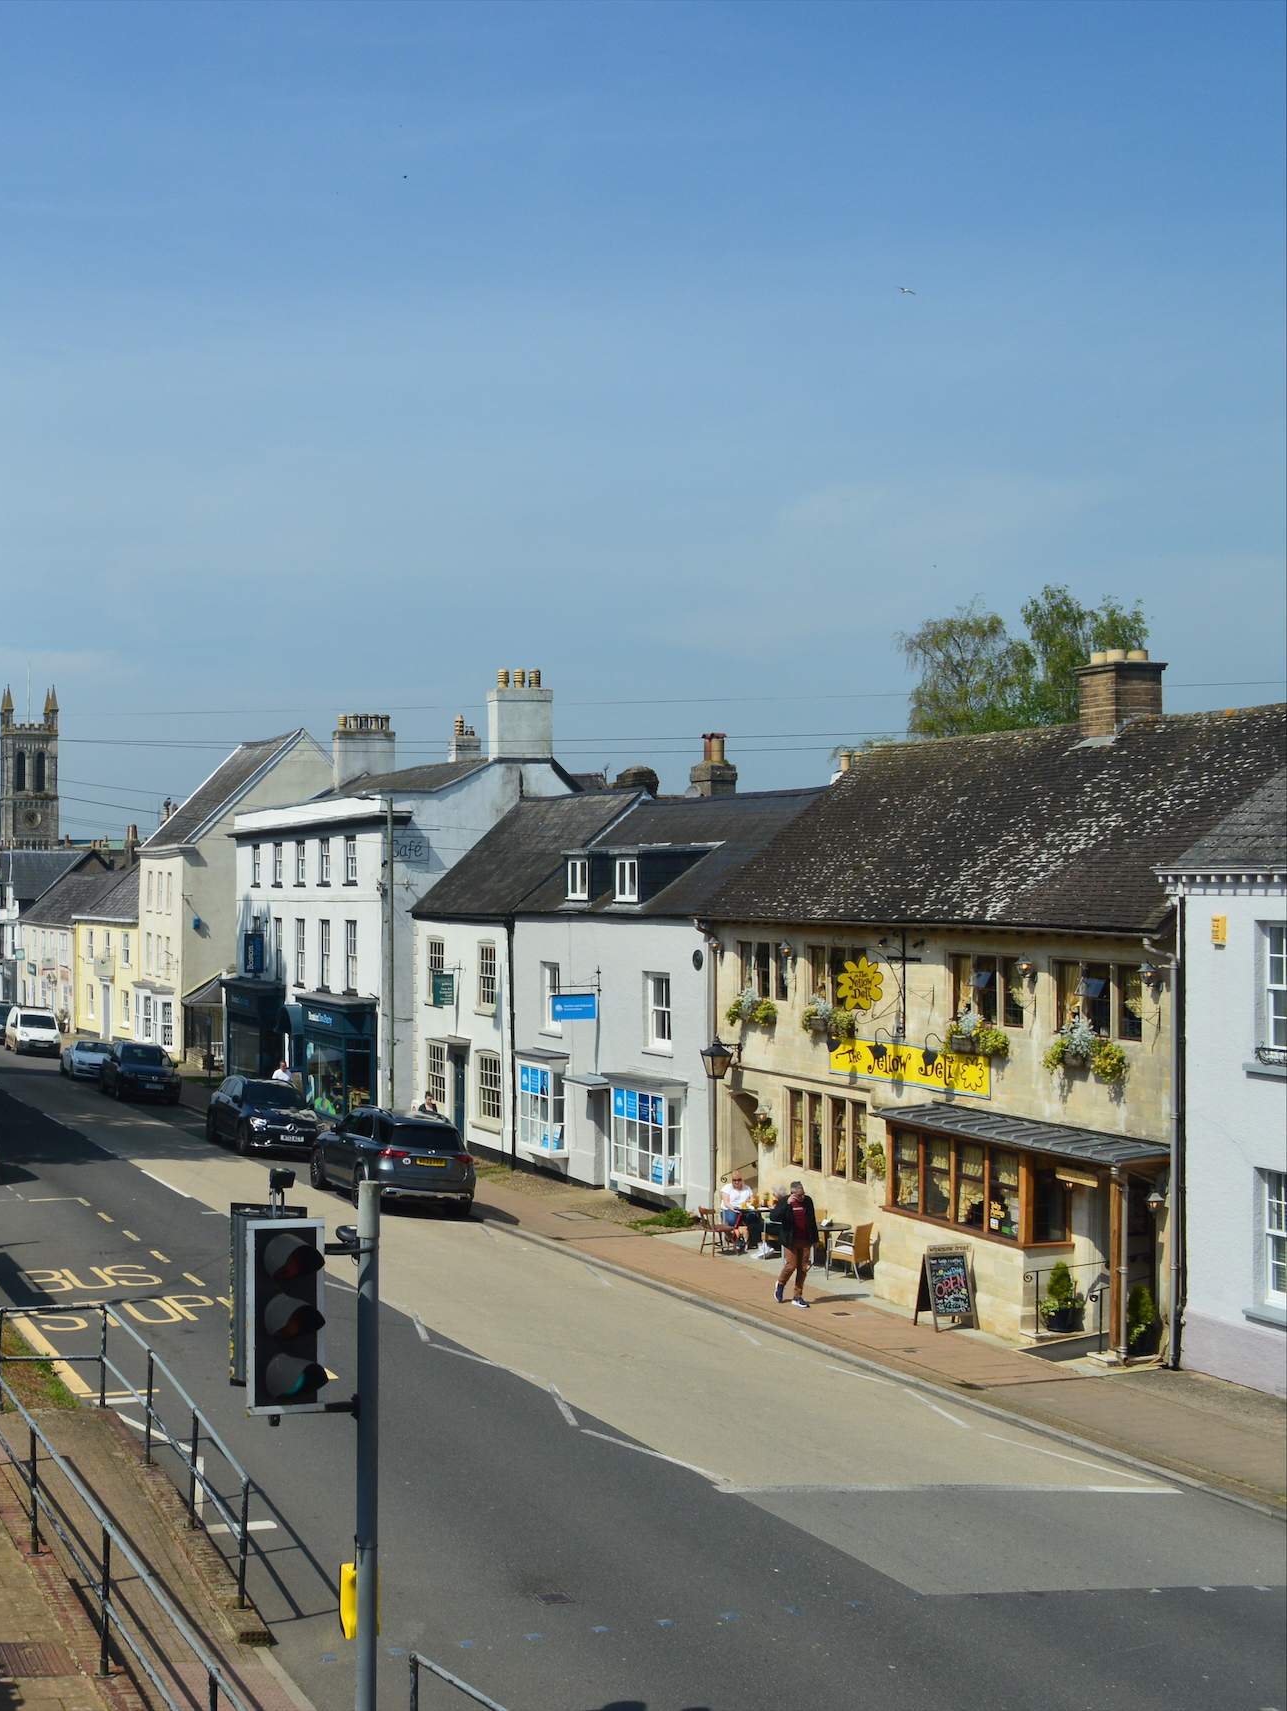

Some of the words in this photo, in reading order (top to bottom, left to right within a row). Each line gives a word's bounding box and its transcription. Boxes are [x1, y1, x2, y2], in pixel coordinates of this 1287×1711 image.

[848, 975, 874, 990] Yellow
[851, 987, 871, 1000] Deli
[835, 1048, 862, 1064] The
[866, 1045, 911, 1074] Yellow
[918, 1055, 955, 1086] Deli
[17, 1264, 163, 1293] BUS
[935, 1274, 966, 1298] OPEN
[28, 1294, 215, 1332] STOP
